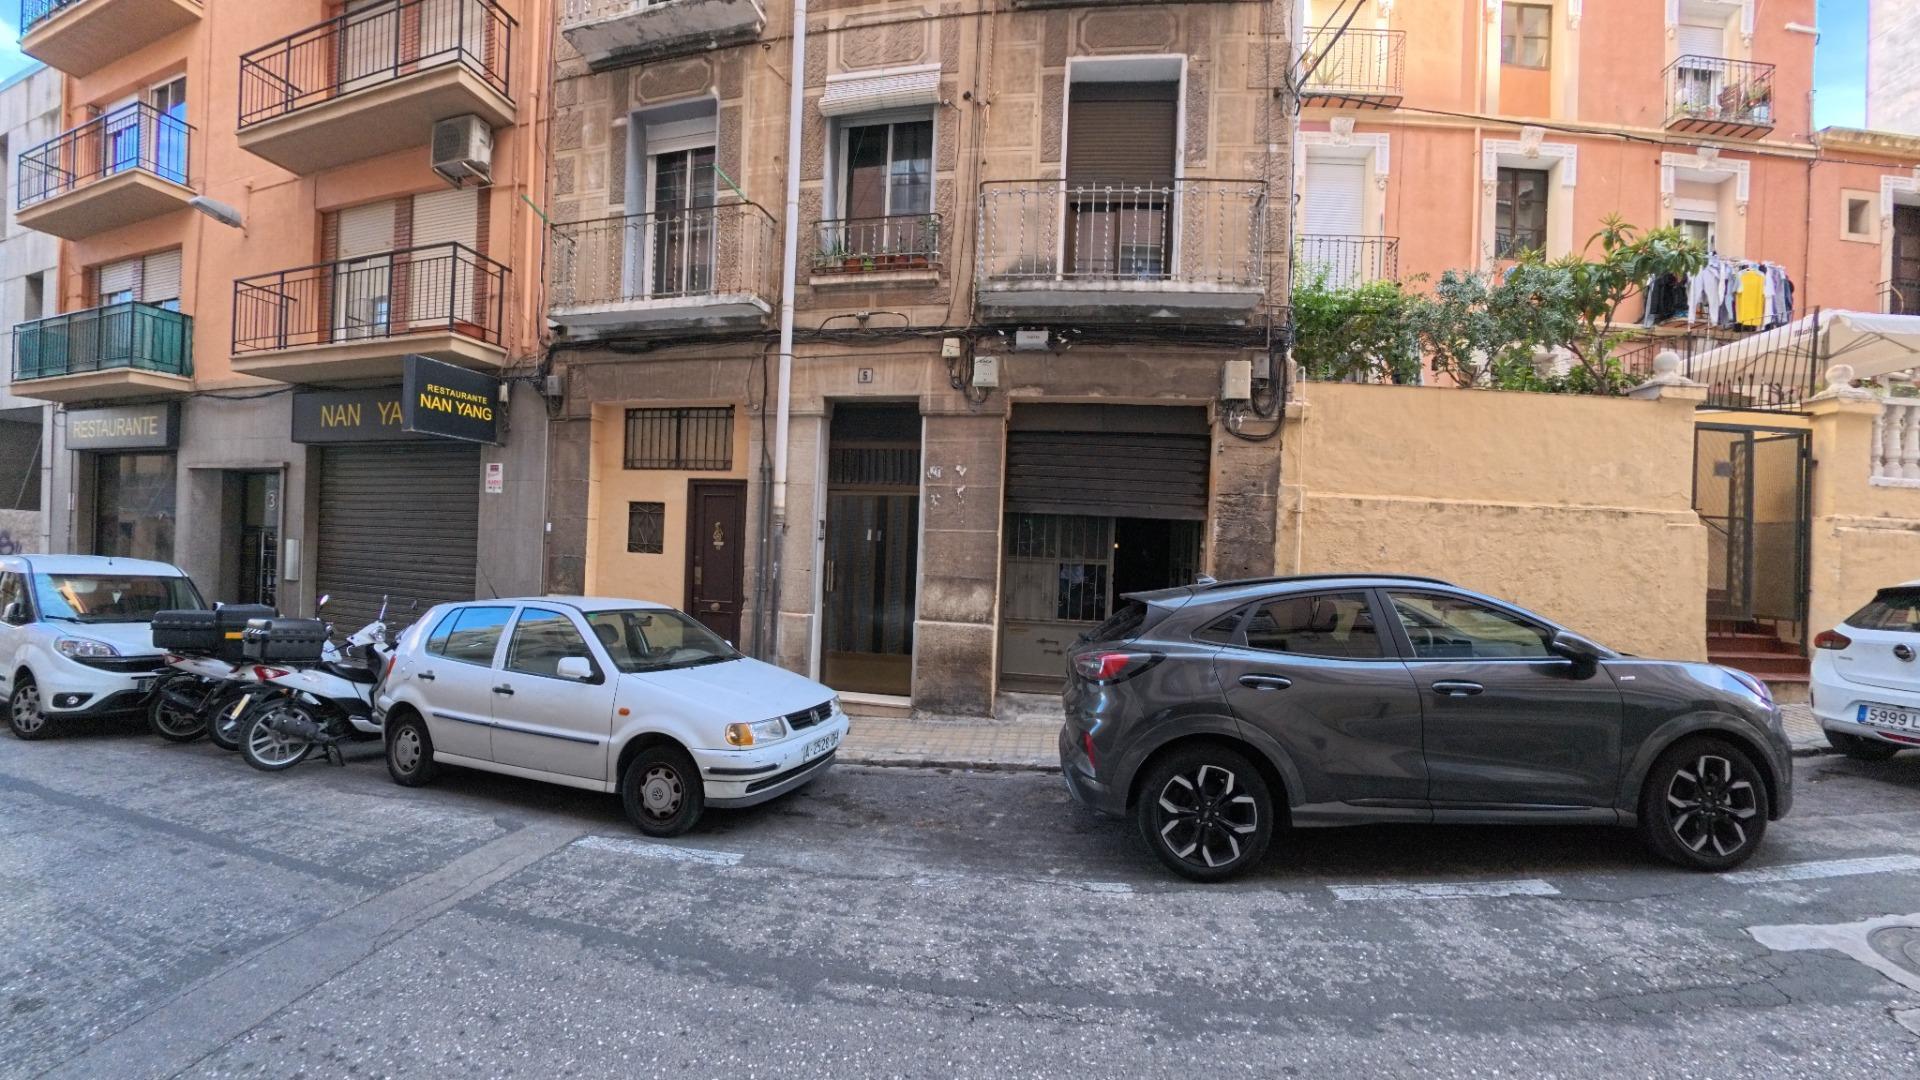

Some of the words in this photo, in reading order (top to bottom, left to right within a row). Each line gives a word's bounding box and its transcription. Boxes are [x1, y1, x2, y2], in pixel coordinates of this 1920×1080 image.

[863, 370, 868, 381] 5
[426, 383, 488, 405] RESTAURANTE
[321, 403, 361, 428] NAN
[377, 401, 404, 425] YA
[420, 393, 452, 413] NAN
[455, 400, 493, 421] YANG
[72, 415, 158, 439] RESTAURANTE
[269, 493, 276, 508] 3
[1870, 708, 1908, 726] 5999
